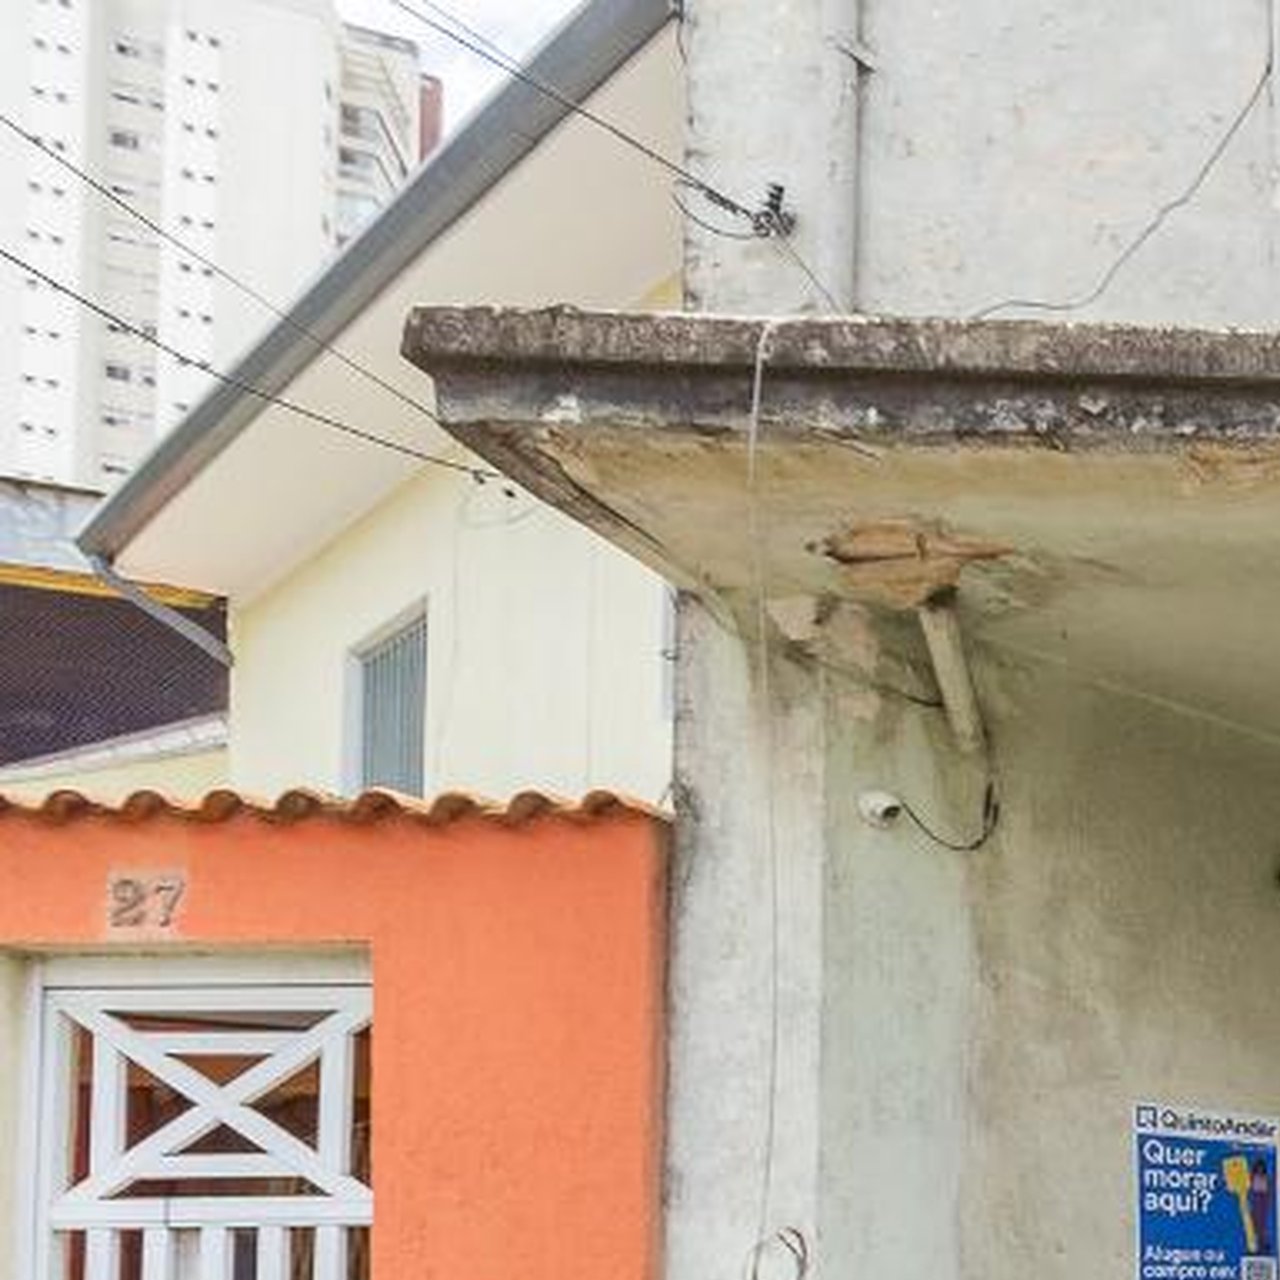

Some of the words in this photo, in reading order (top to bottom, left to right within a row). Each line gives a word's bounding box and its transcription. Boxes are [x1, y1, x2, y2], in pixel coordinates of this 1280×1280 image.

[111, 879, 186, 929] 27
[1143, 1139, 1207, 1166] Quer
[1144, 1168, 1218, 1190] morar
[1144, 1189, 1213, 1215] aqui?
